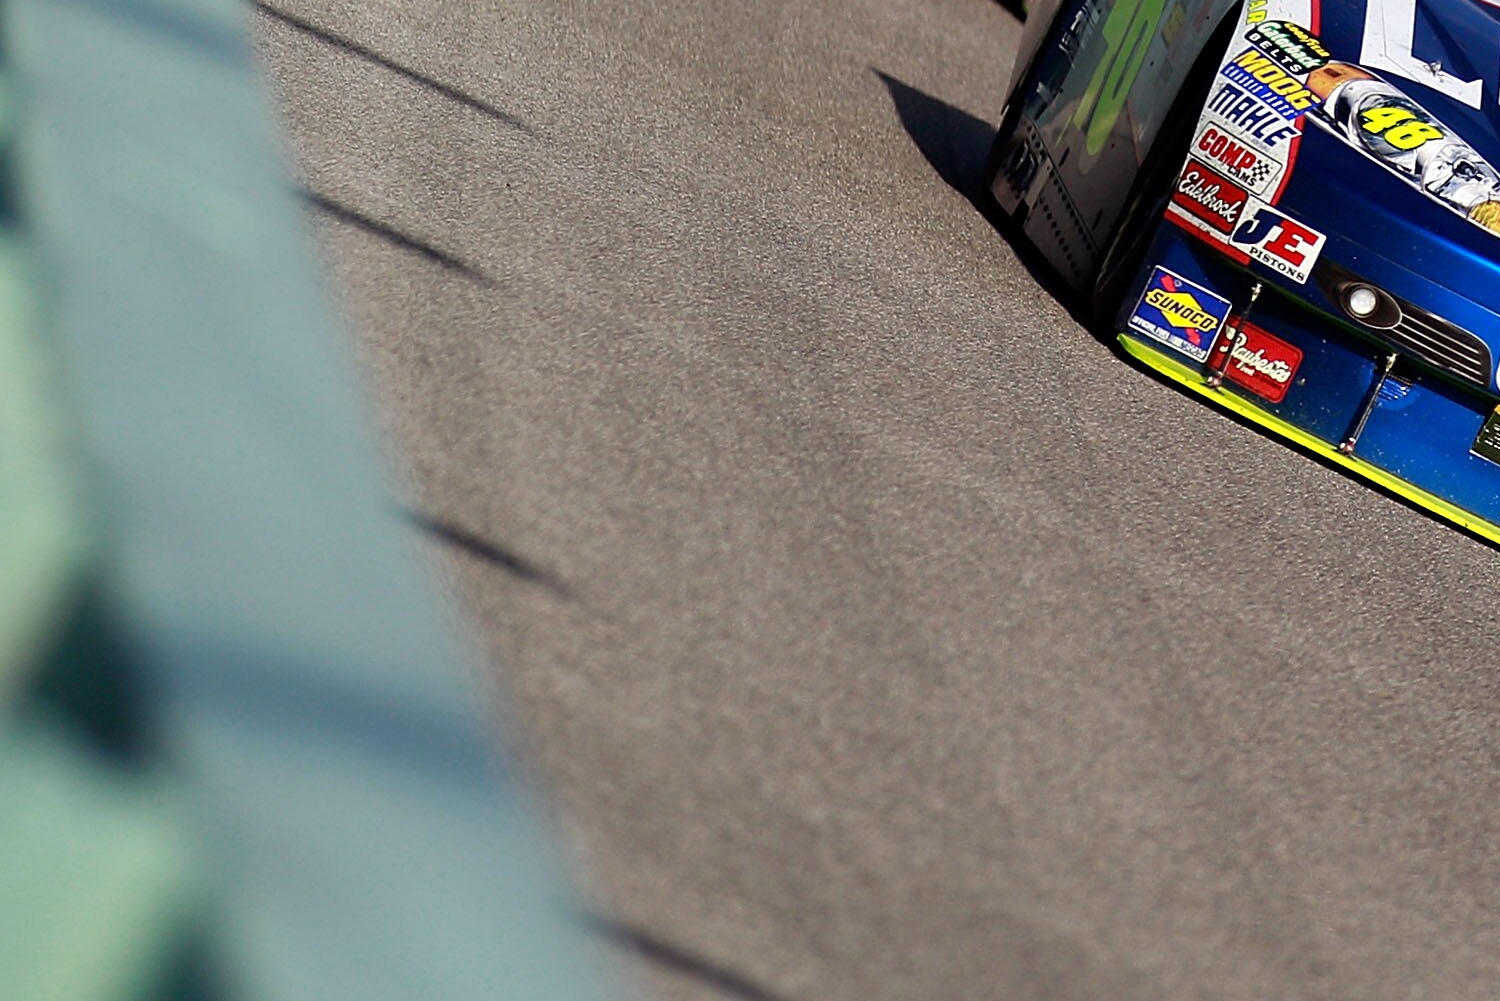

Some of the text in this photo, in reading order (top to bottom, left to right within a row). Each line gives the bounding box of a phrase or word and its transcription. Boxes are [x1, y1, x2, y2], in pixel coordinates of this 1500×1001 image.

[1249, 32, 1302, 73] BELTS
[1233, 50, 1321, 111] MOOG
[1208, 83, 1298, 147] MAHLE
[1361, 105, 1444, 151] 48
[1199, 128, 1257, 170] COMP
[1178, 171, 1242, 223] Edelbrock
[1227, 165, 1257, 187] CAMS
[1232, 208, 1319, 267] JE
[1249, 246, 1306, 282] PISTONS
[1149, 291, 1216, 331] SUNOCO
